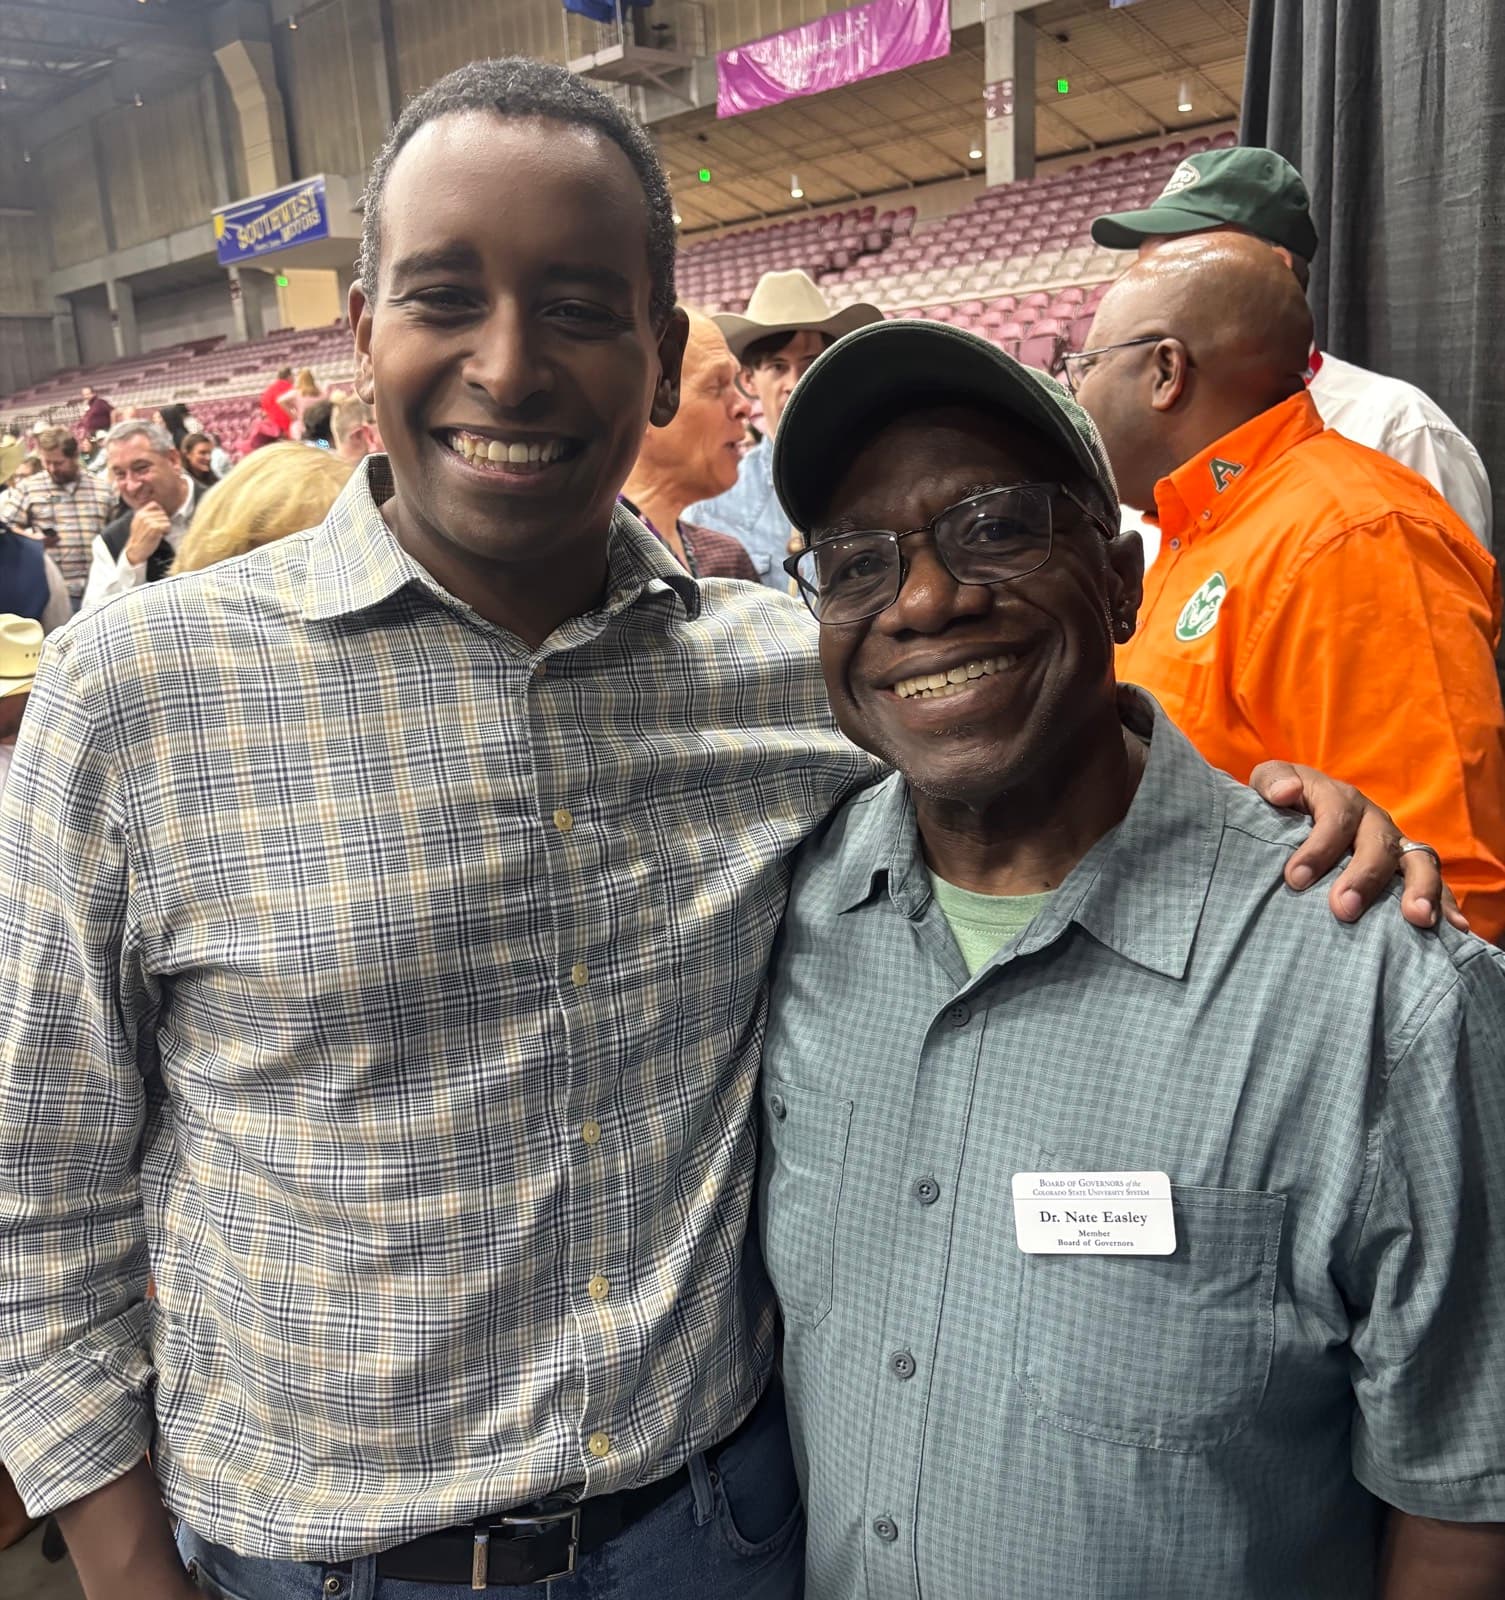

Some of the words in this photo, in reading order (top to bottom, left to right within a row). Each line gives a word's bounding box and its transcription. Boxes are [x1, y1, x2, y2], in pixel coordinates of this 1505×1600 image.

[237, 187, 317, 250] SOUTHWEST
[280, 208, 321, 242] MOTORS
[1209, 457, 1244, 493] A
[1040, 1211, 1061, 1223] Dr.
[1065, 1211, 1099, 1223] Nate
[1103, 1211, 1148, 1226] Easley
[1078, 1229, 1110, 1237] Member
[1094, 1239, 1134, 1247] Governors
